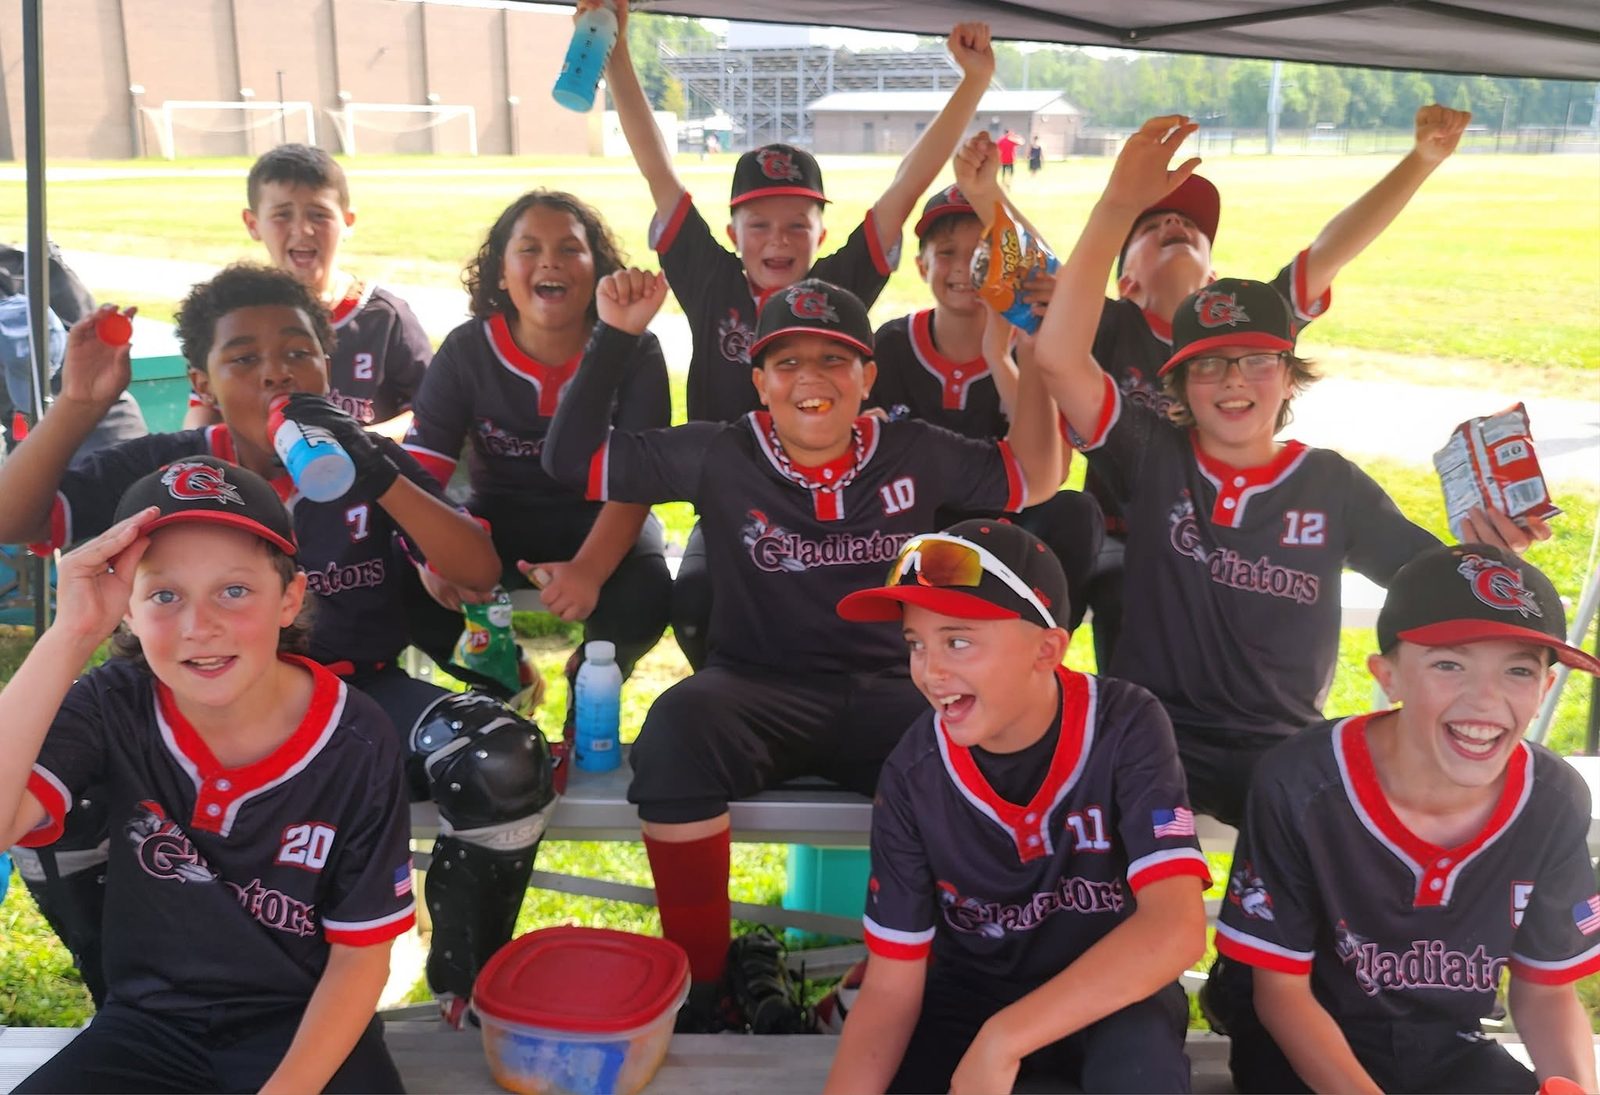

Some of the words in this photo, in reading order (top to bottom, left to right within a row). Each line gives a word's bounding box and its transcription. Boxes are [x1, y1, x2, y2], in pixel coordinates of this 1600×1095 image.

[353, 352, 374, 381] 2
[878, 476, 916, 516] 10
[345, 504, 368, 541] 7
[1280, 509, 1327, 547] 12
[752, 530, 914, 573] Gladiator
[1170, 514, 1320, 606] Gdiators
[277, 823, 336, 871] 20
[1067, 807, 1111, 851] 11
